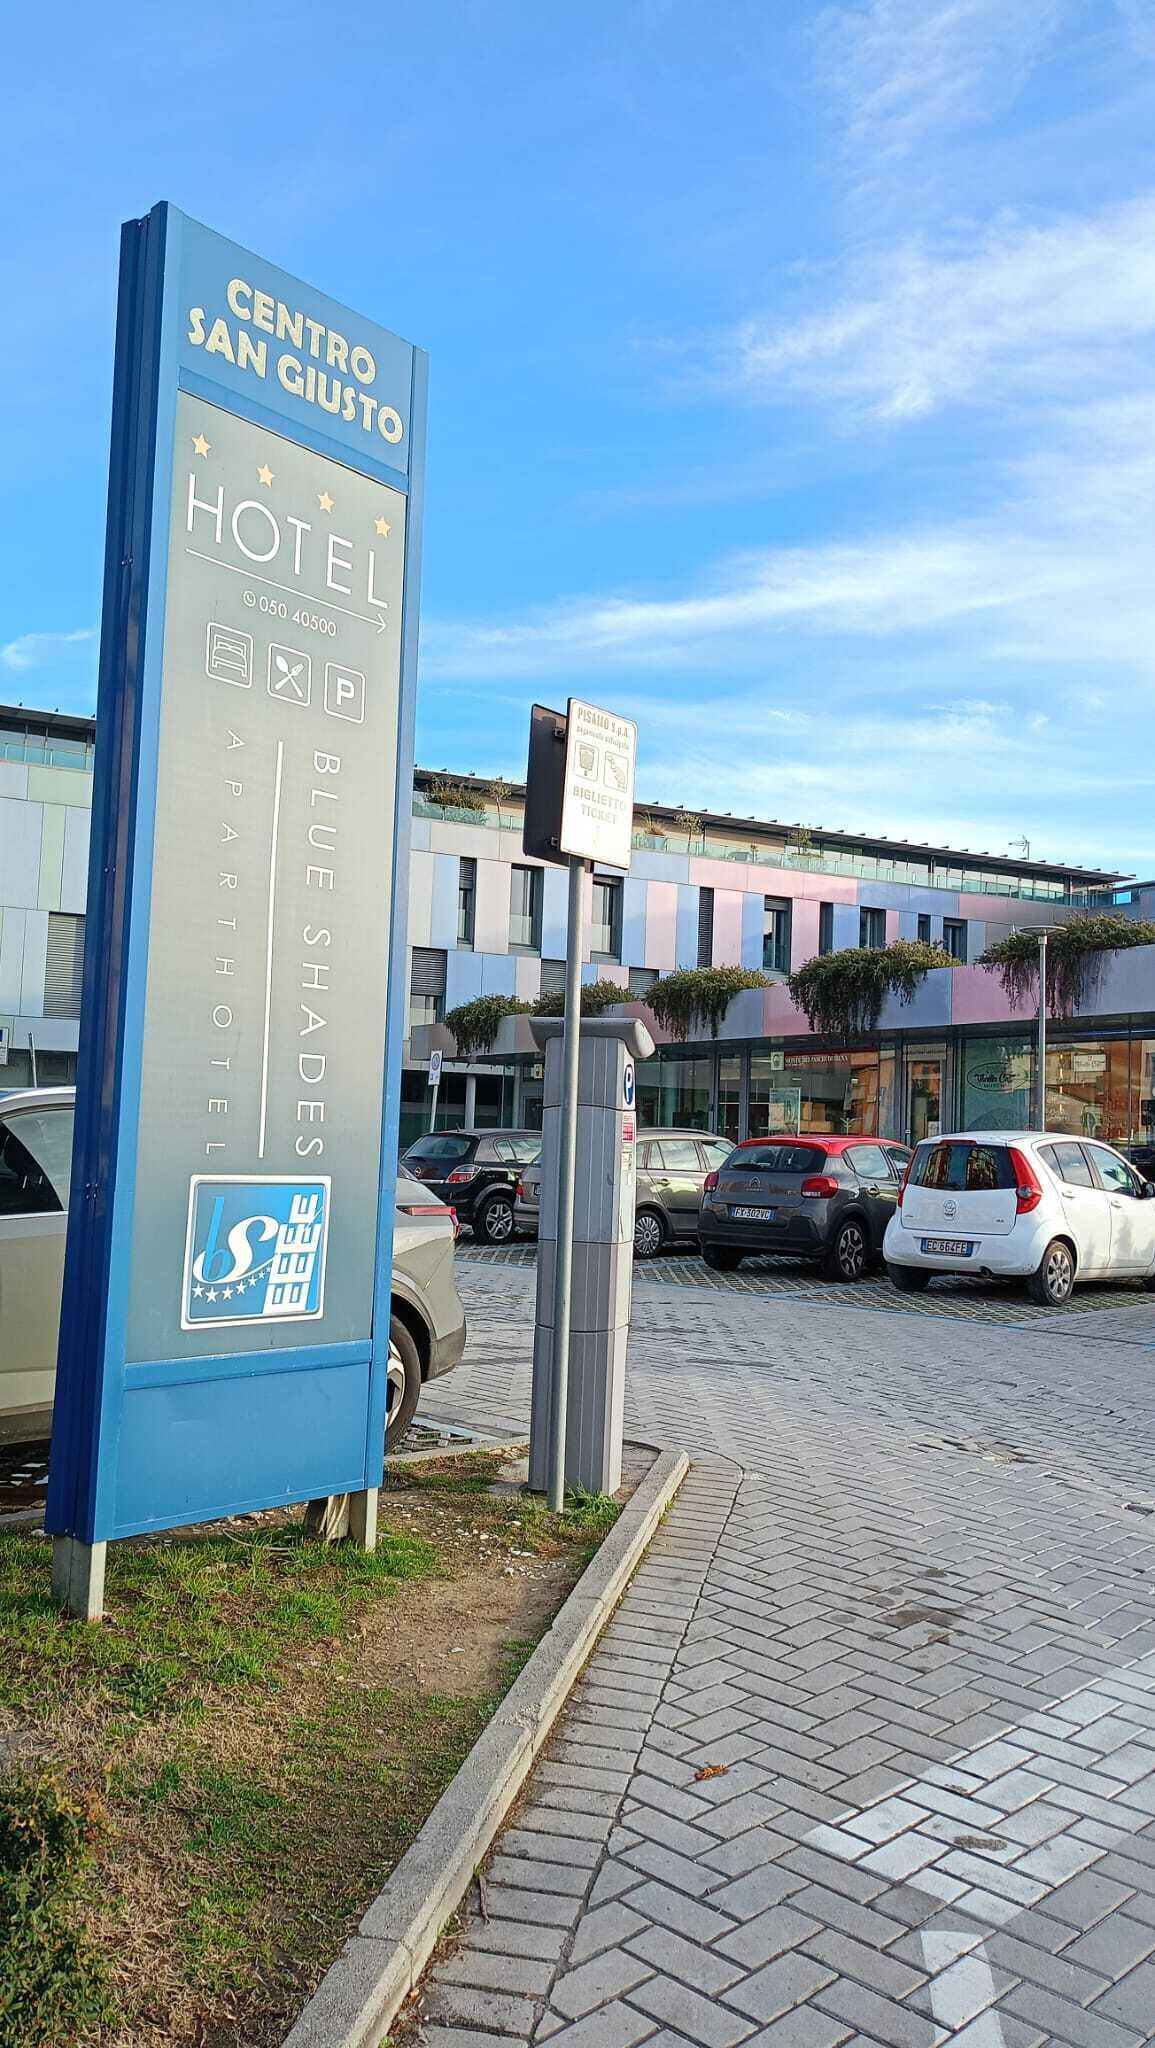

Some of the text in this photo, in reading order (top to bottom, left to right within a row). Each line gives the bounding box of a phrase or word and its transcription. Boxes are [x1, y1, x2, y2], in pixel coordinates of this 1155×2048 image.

[187, 307, 404, 444] SAN GIUSTO
[227, 278, 376, 385] CENTRO
[186, 473, 388, 609] HOTEL
[259, 596, 337, 637] 050 40500
[336, 677, 355, 706] P
[573, 784, 627, 811] BIGLIETTO
[581, 803, 619, 824] TICKET
[206, 729, 246, 1156] APARTHOTEL
[295, 750, 341, 1158] BLUE SHADES
